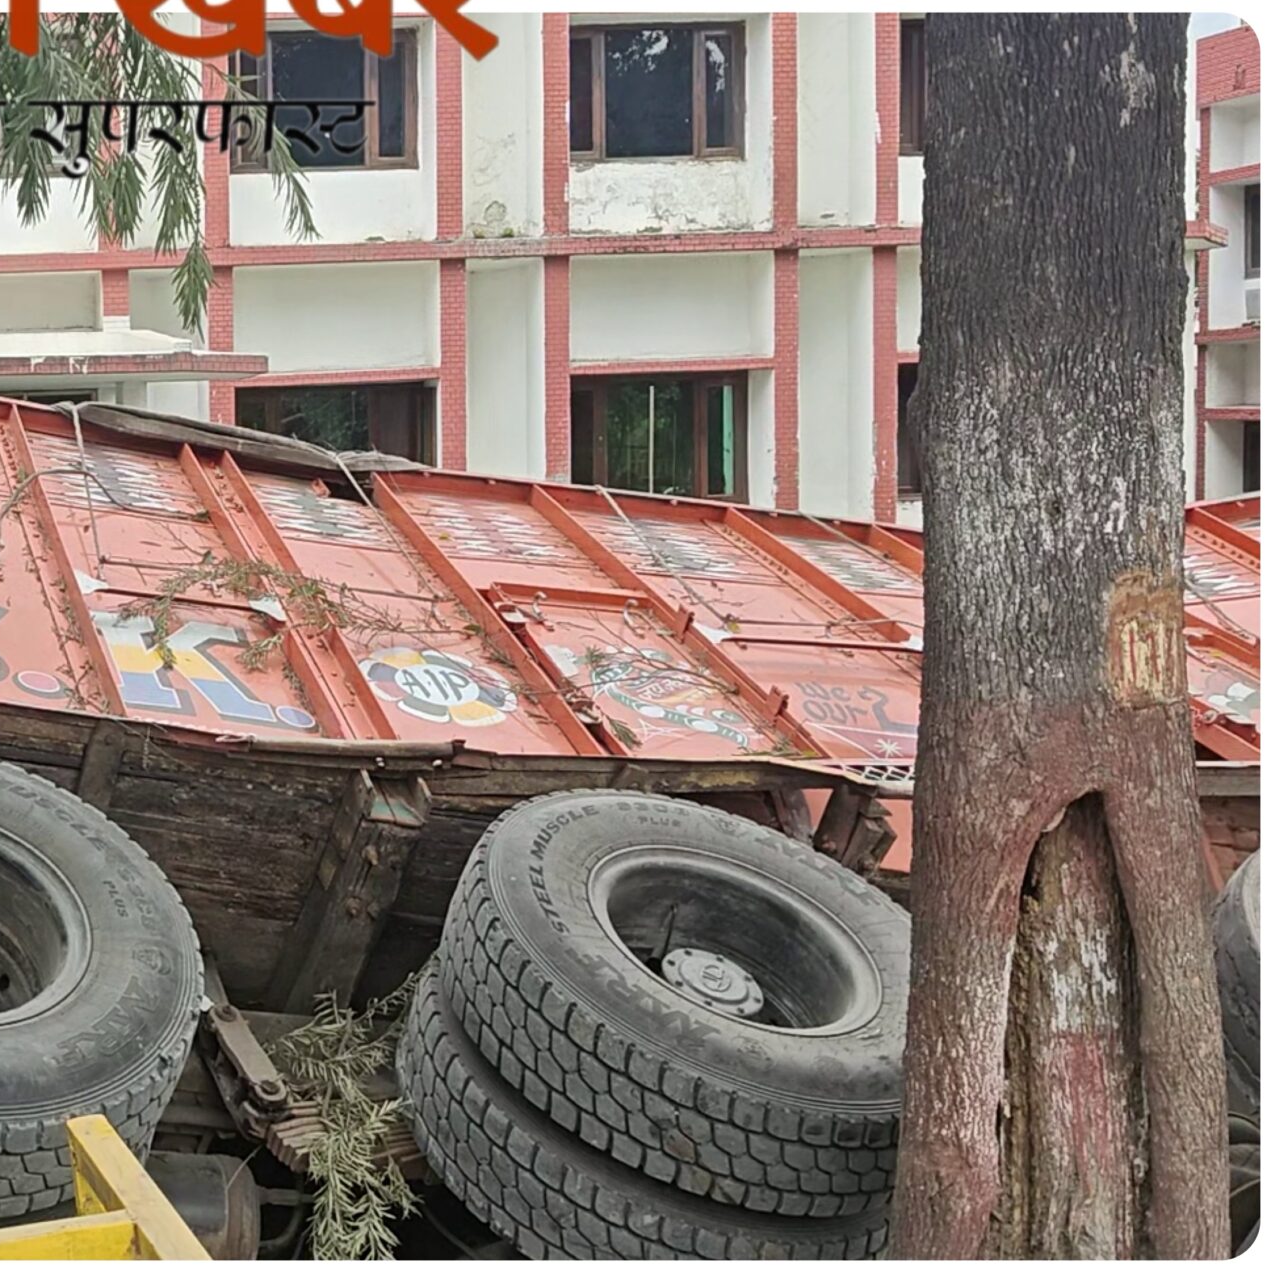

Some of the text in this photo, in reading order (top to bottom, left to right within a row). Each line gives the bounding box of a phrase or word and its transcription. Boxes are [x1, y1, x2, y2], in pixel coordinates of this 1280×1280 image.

[530, 803, 601, 862] MUSCLE
[102, 879, 129, 919] PLUS
[528, 864, 571, 936] STEEL
